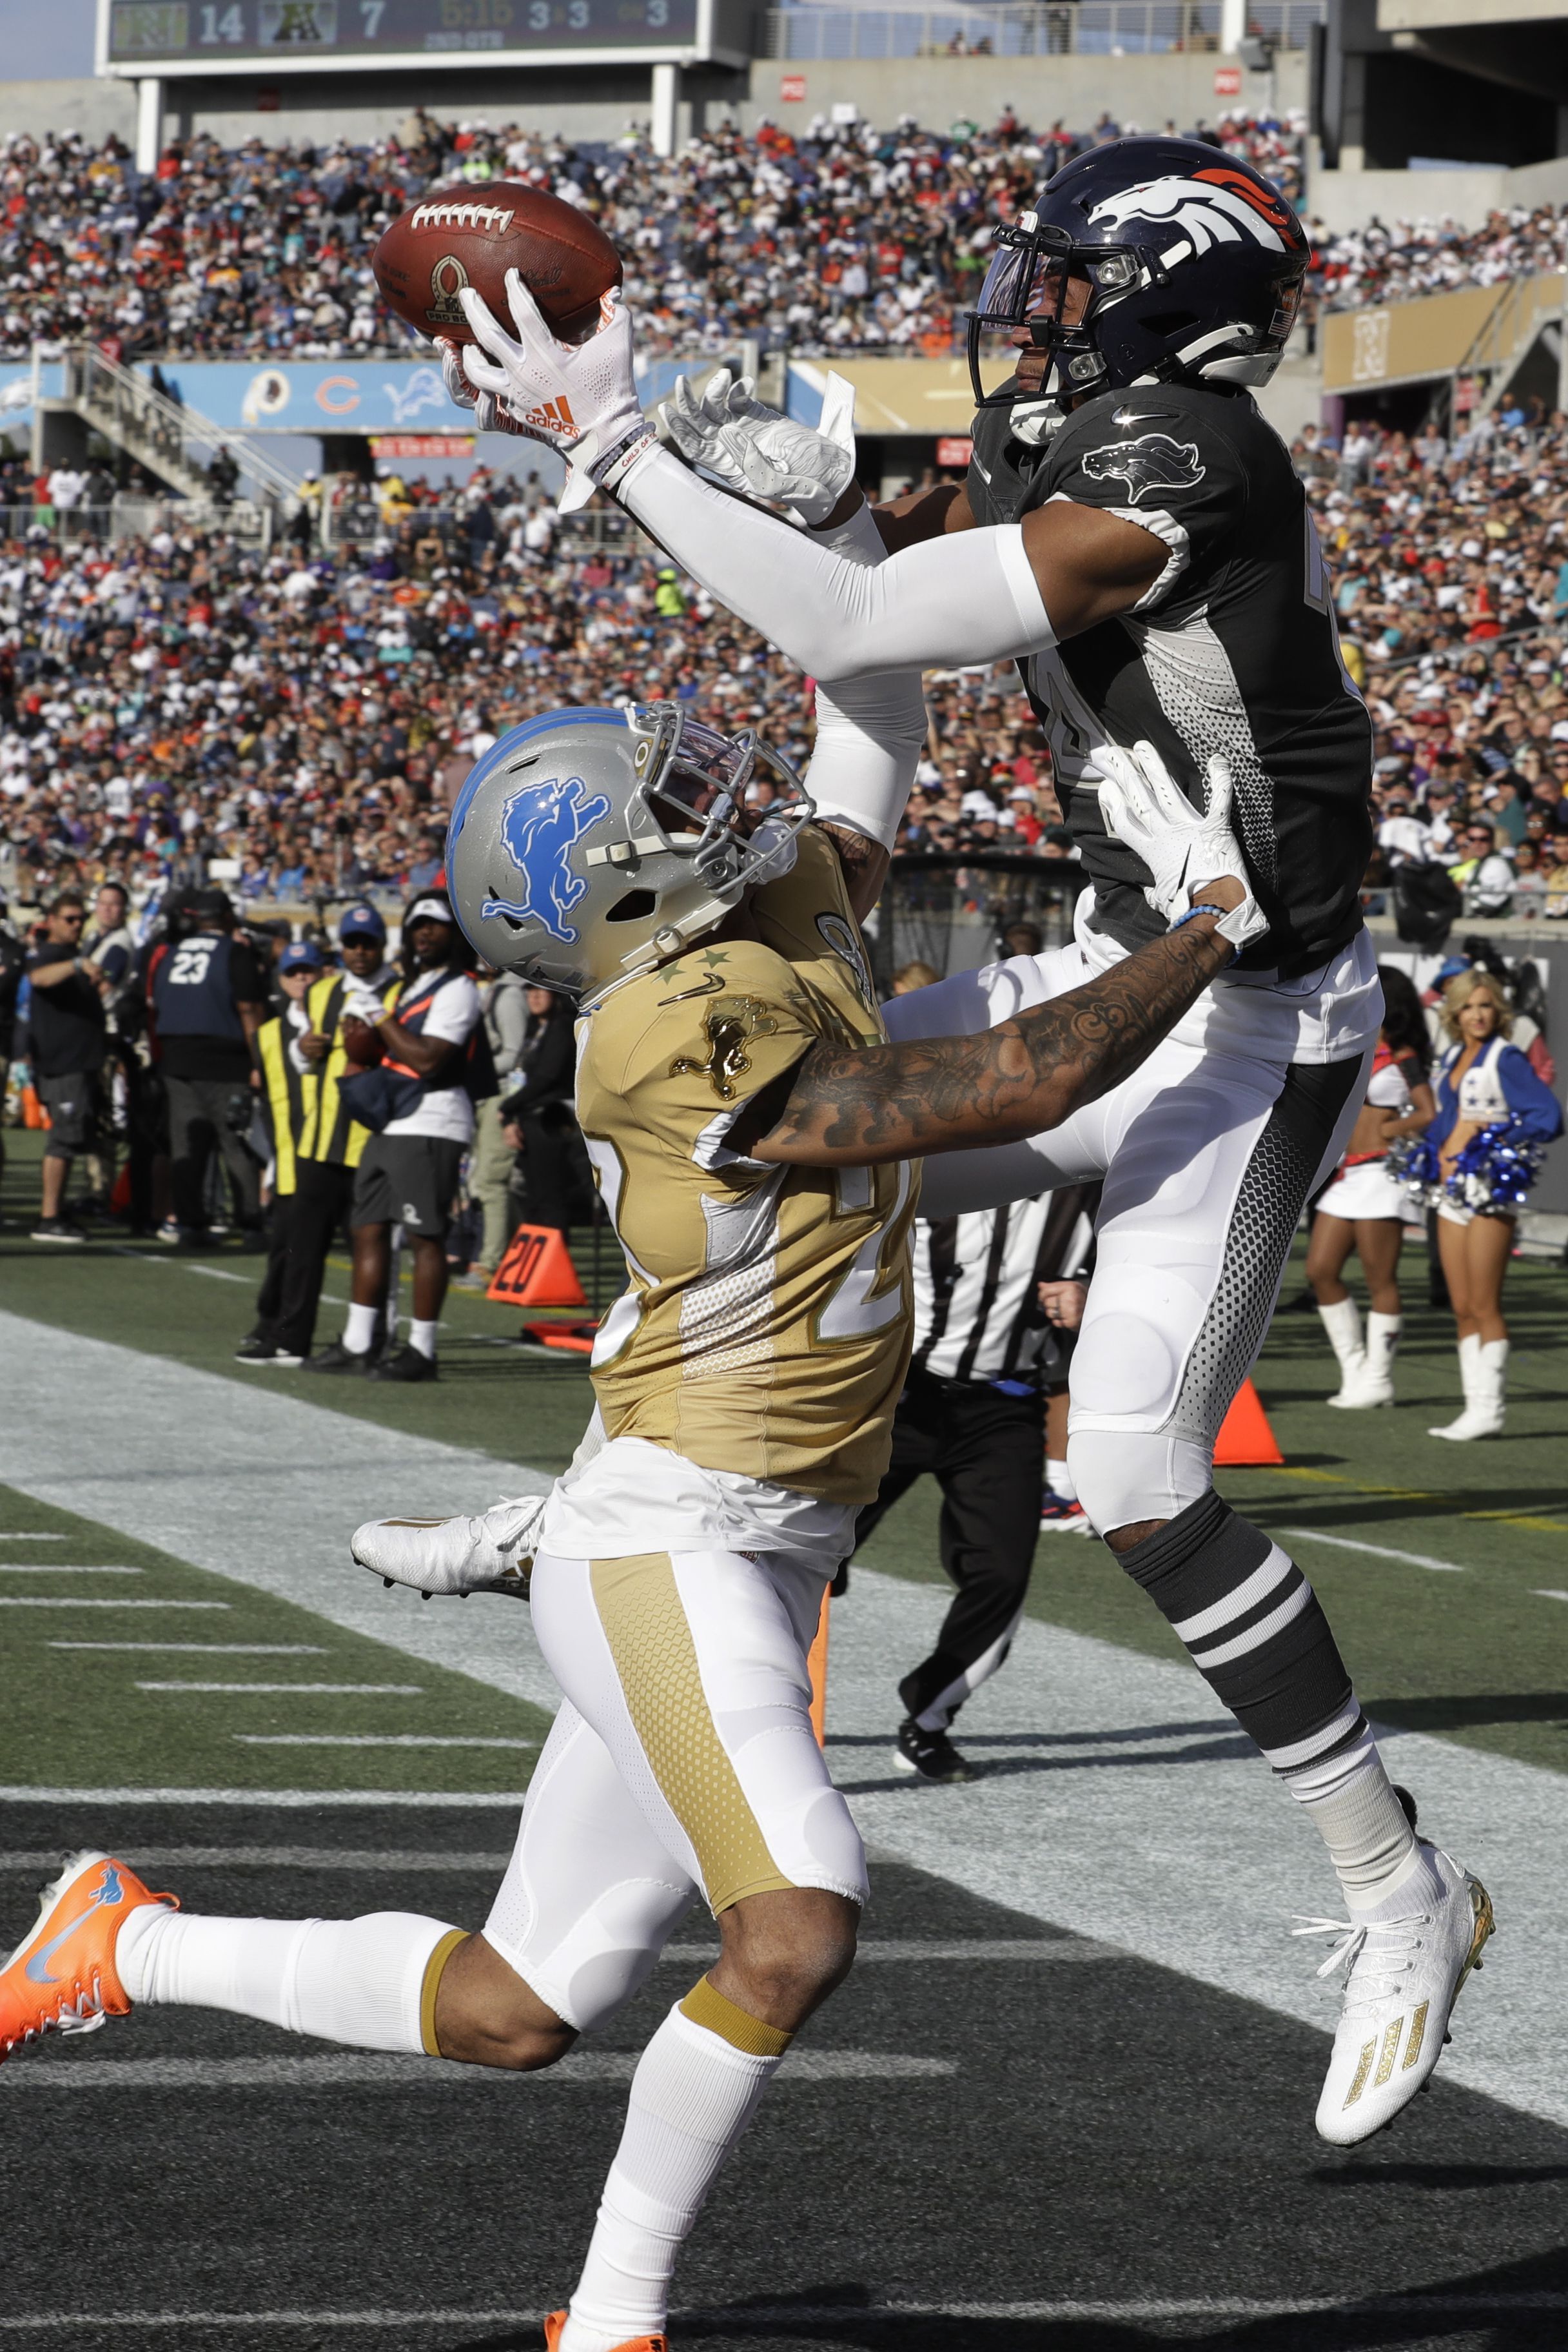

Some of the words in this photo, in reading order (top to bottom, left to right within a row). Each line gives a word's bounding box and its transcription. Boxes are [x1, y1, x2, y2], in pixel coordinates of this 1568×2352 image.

[200, 5, 245, 43] 14
[360, 1, 385, 38] 7
[528, 1, 552, 30] 3
[567, 1, 589, 29] 3
[429, 312, 449, 320] PRO
[525, 414, 580, 440] adidas
[622, 448, 640, 467] CHILD
[641, 438, 649, 448] OF
[168, 952, 210, 985] 23
[495, 1232, 547, 1294] 20
